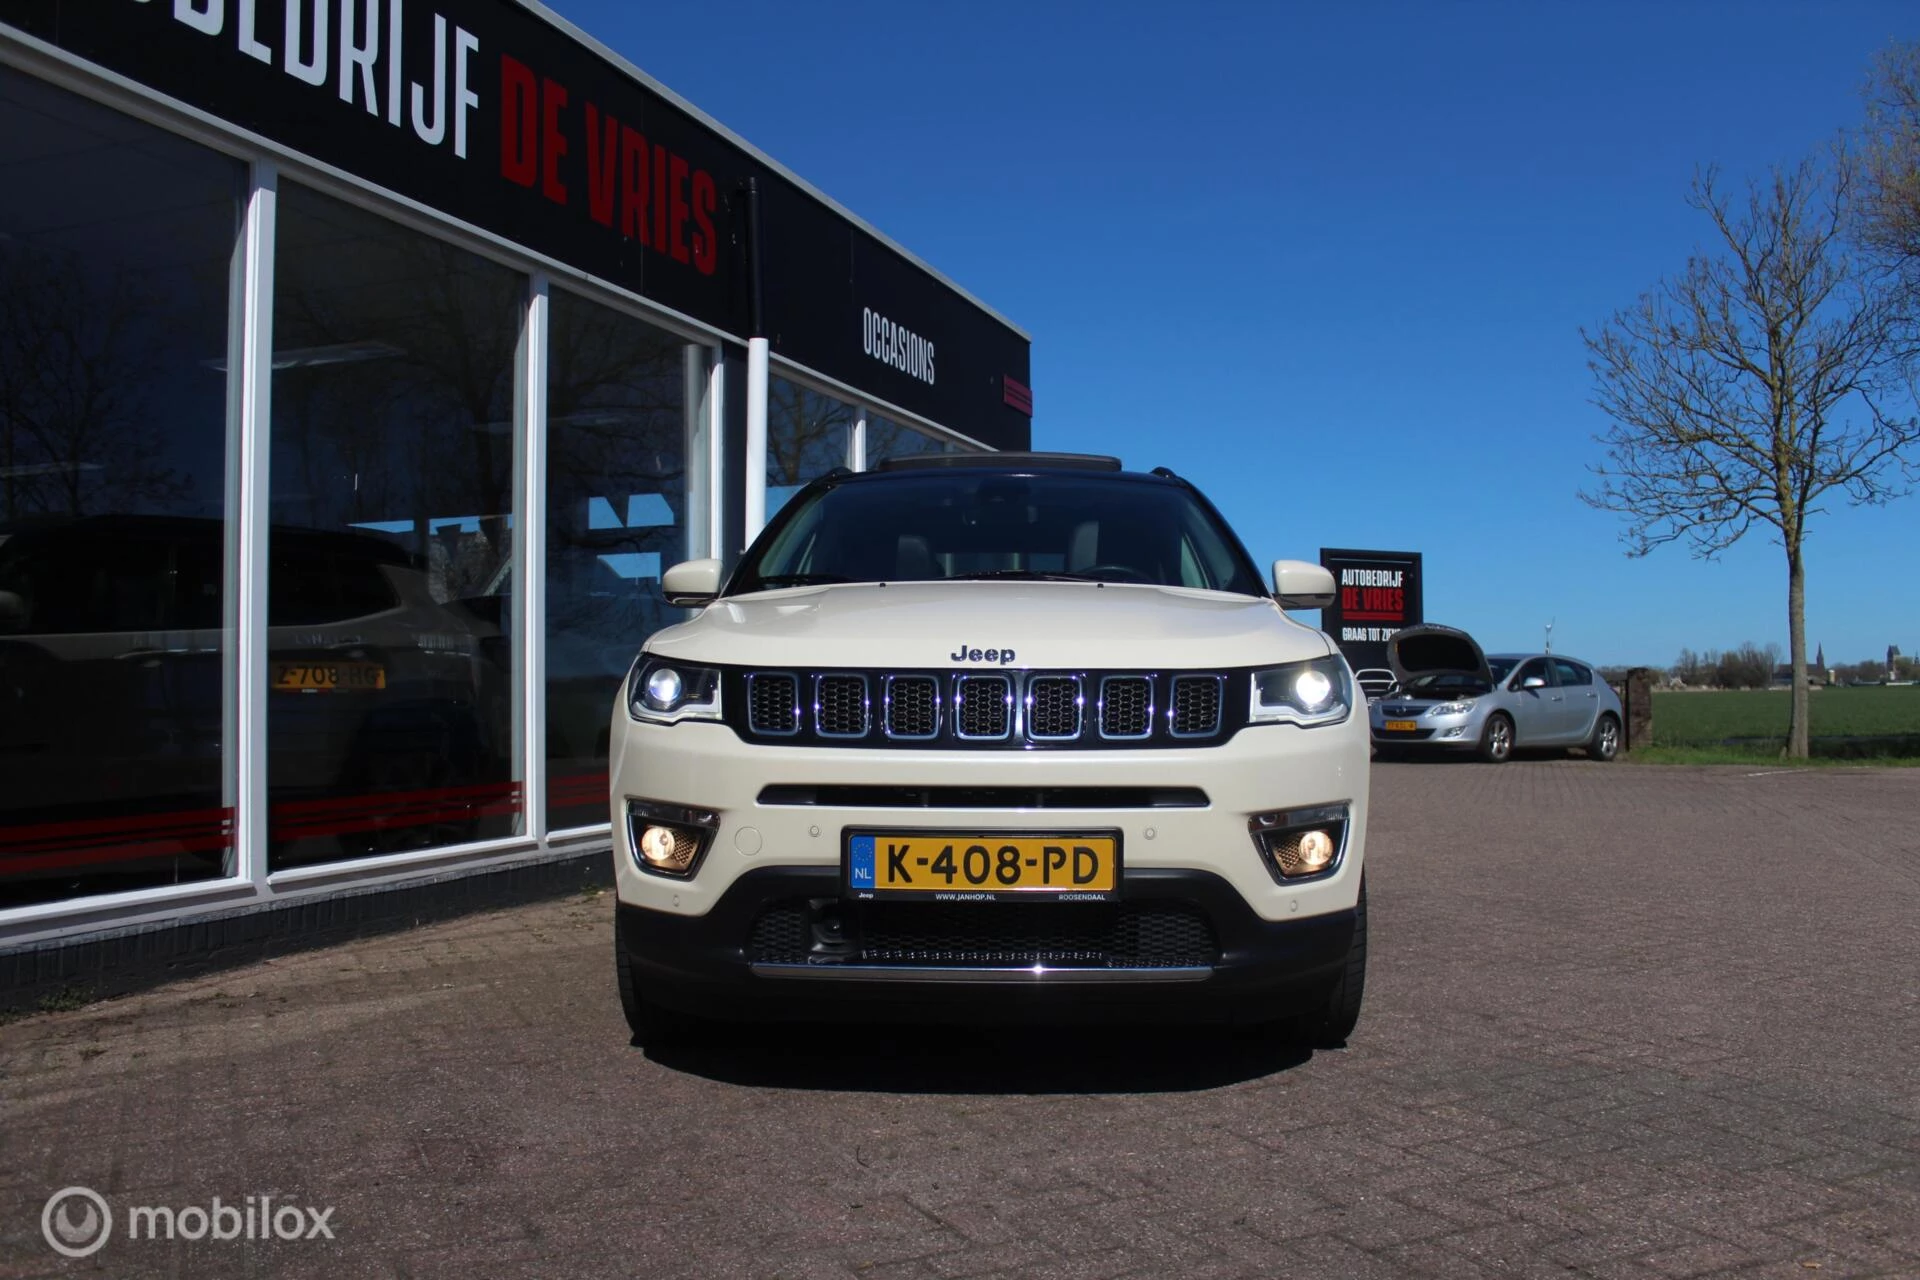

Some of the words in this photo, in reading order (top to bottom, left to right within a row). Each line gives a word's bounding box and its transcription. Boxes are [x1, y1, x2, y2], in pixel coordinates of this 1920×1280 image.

[501, 52, 569, 206] DE
[584, 101, 716, 275] VRIES
[863, 306, 935, 385] OCCASIONS
[1341, 568, 1403, 588] AUTOBEDRIJF
[1342, 588, 1359, 610] DE
[1363, 589, 1404, 611] VRIES
[1342, 627, 1367, 642] GRAAG
[1368, 627, 1380, 641] TOT
[951, 645, 1016, 665] Jeep
[854, 867, 872, 880] NL
[887, 844, 1099, 885] K-408-PD
